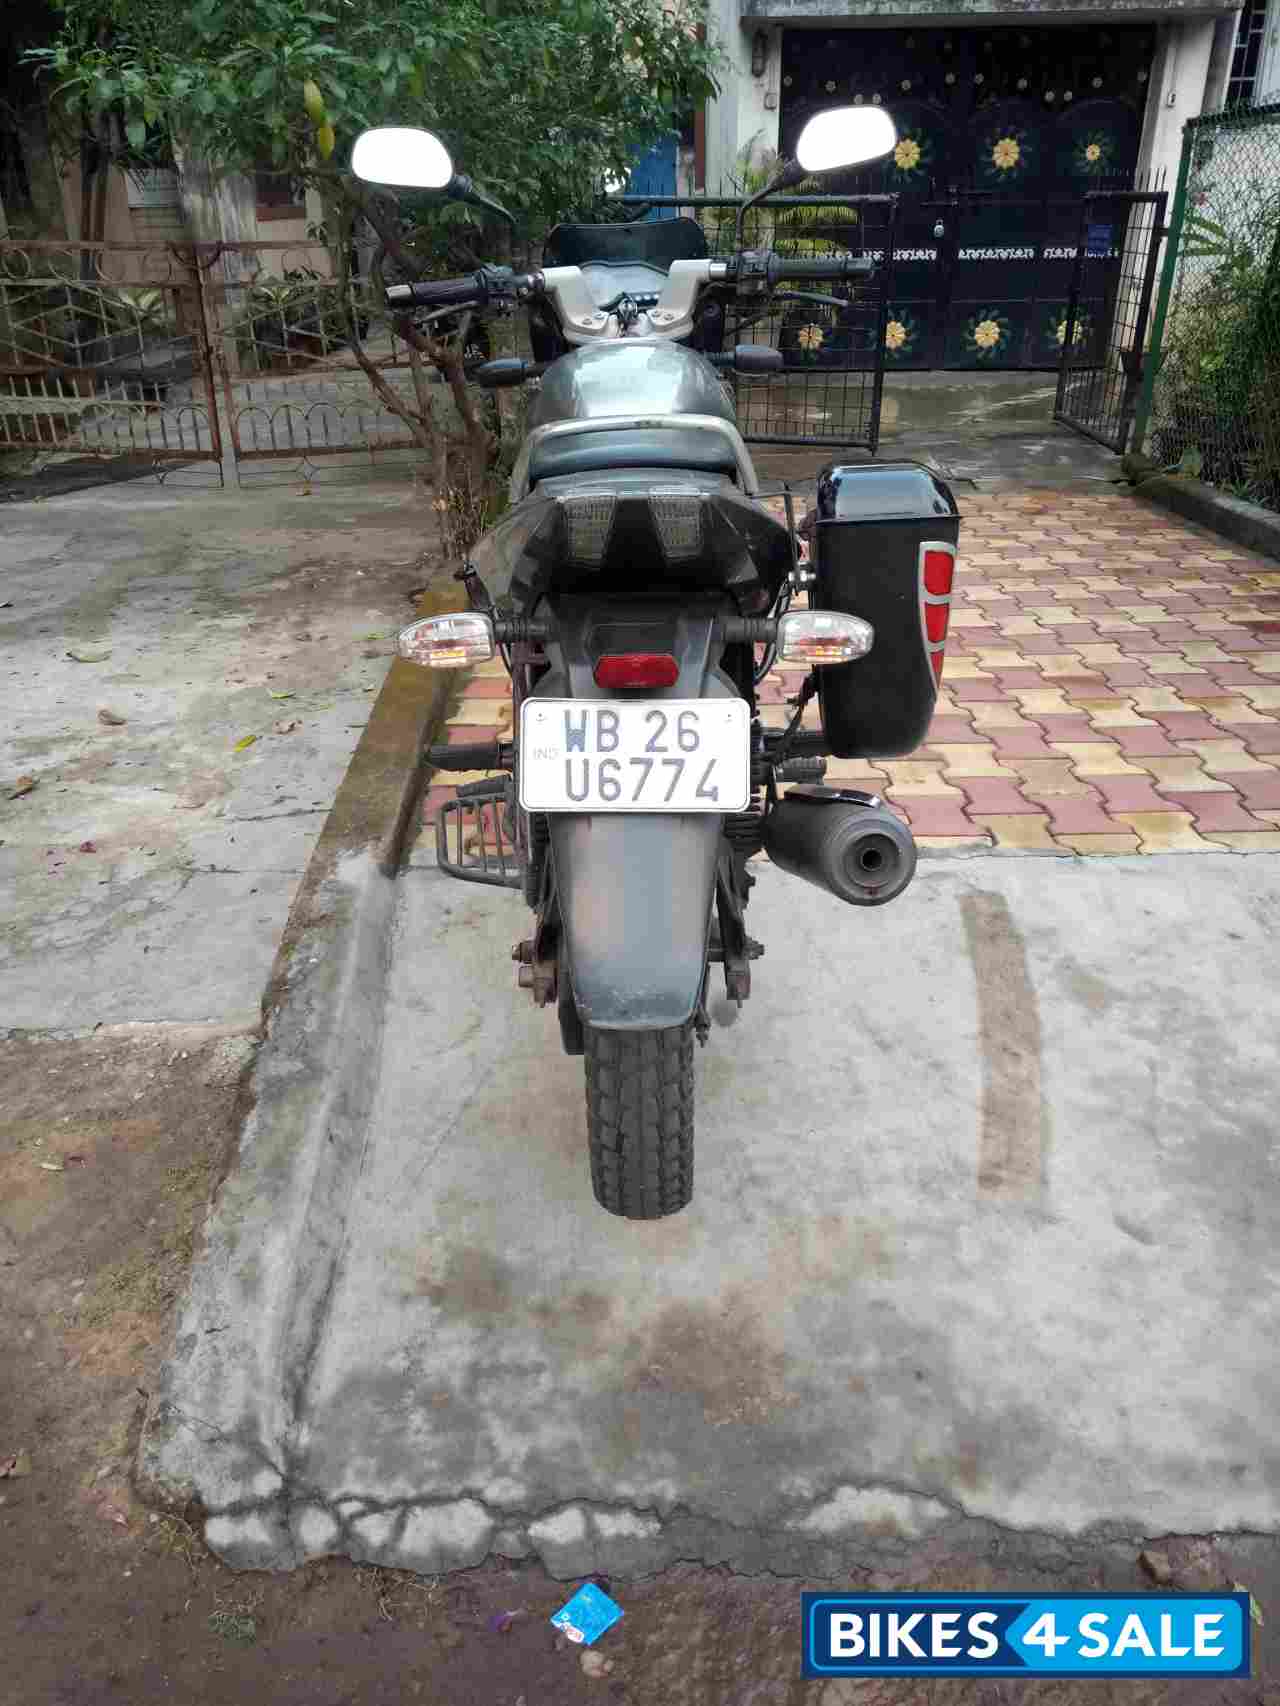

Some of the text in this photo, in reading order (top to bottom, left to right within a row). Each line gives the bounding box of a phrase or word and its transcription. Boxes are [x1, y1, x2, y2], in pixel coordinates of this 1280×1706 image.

[564, 709, 700, 752] WB 26
[565, 757, 719, 802] U6774
